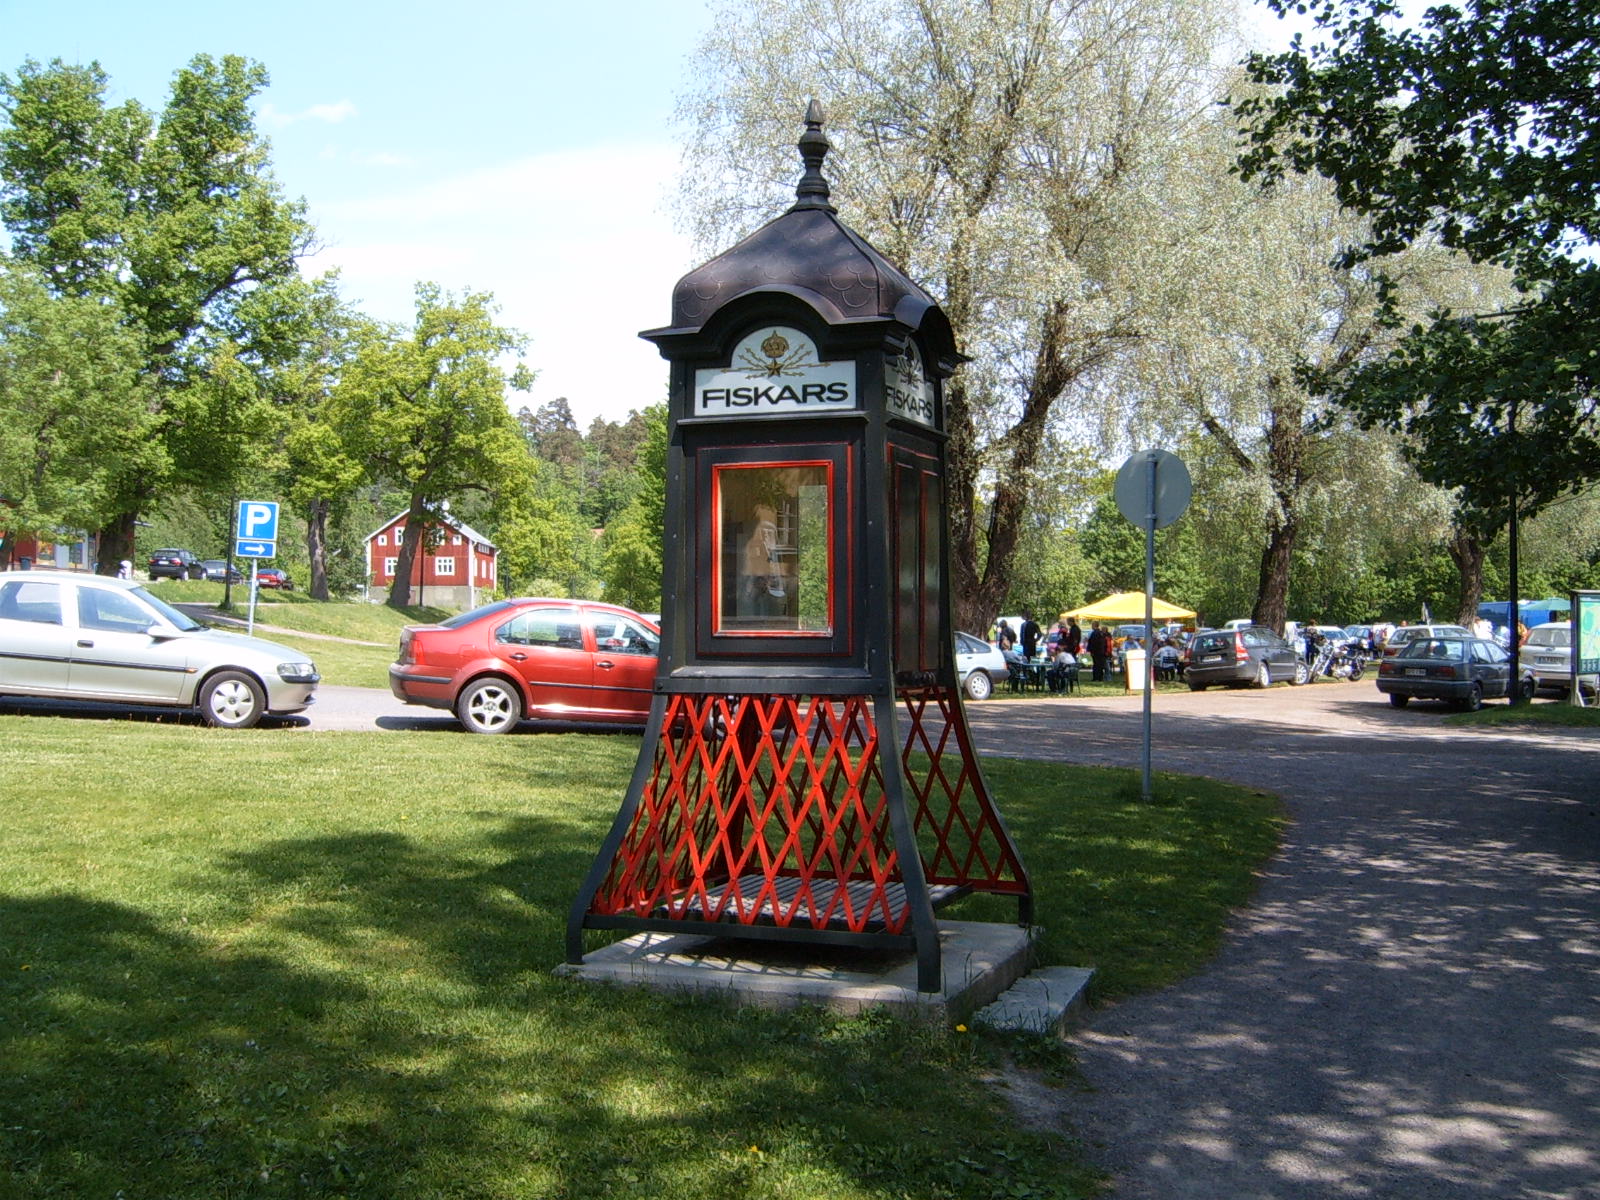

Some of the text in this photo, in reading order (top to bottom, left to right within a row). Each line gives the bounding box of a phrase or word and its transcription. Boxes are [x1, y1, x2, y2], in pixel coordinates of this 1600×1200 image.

[702, 382, 849, 409] FISKARS
[886, 384, 933, 421] FISKARS
[246, 504, 272, 536] P
